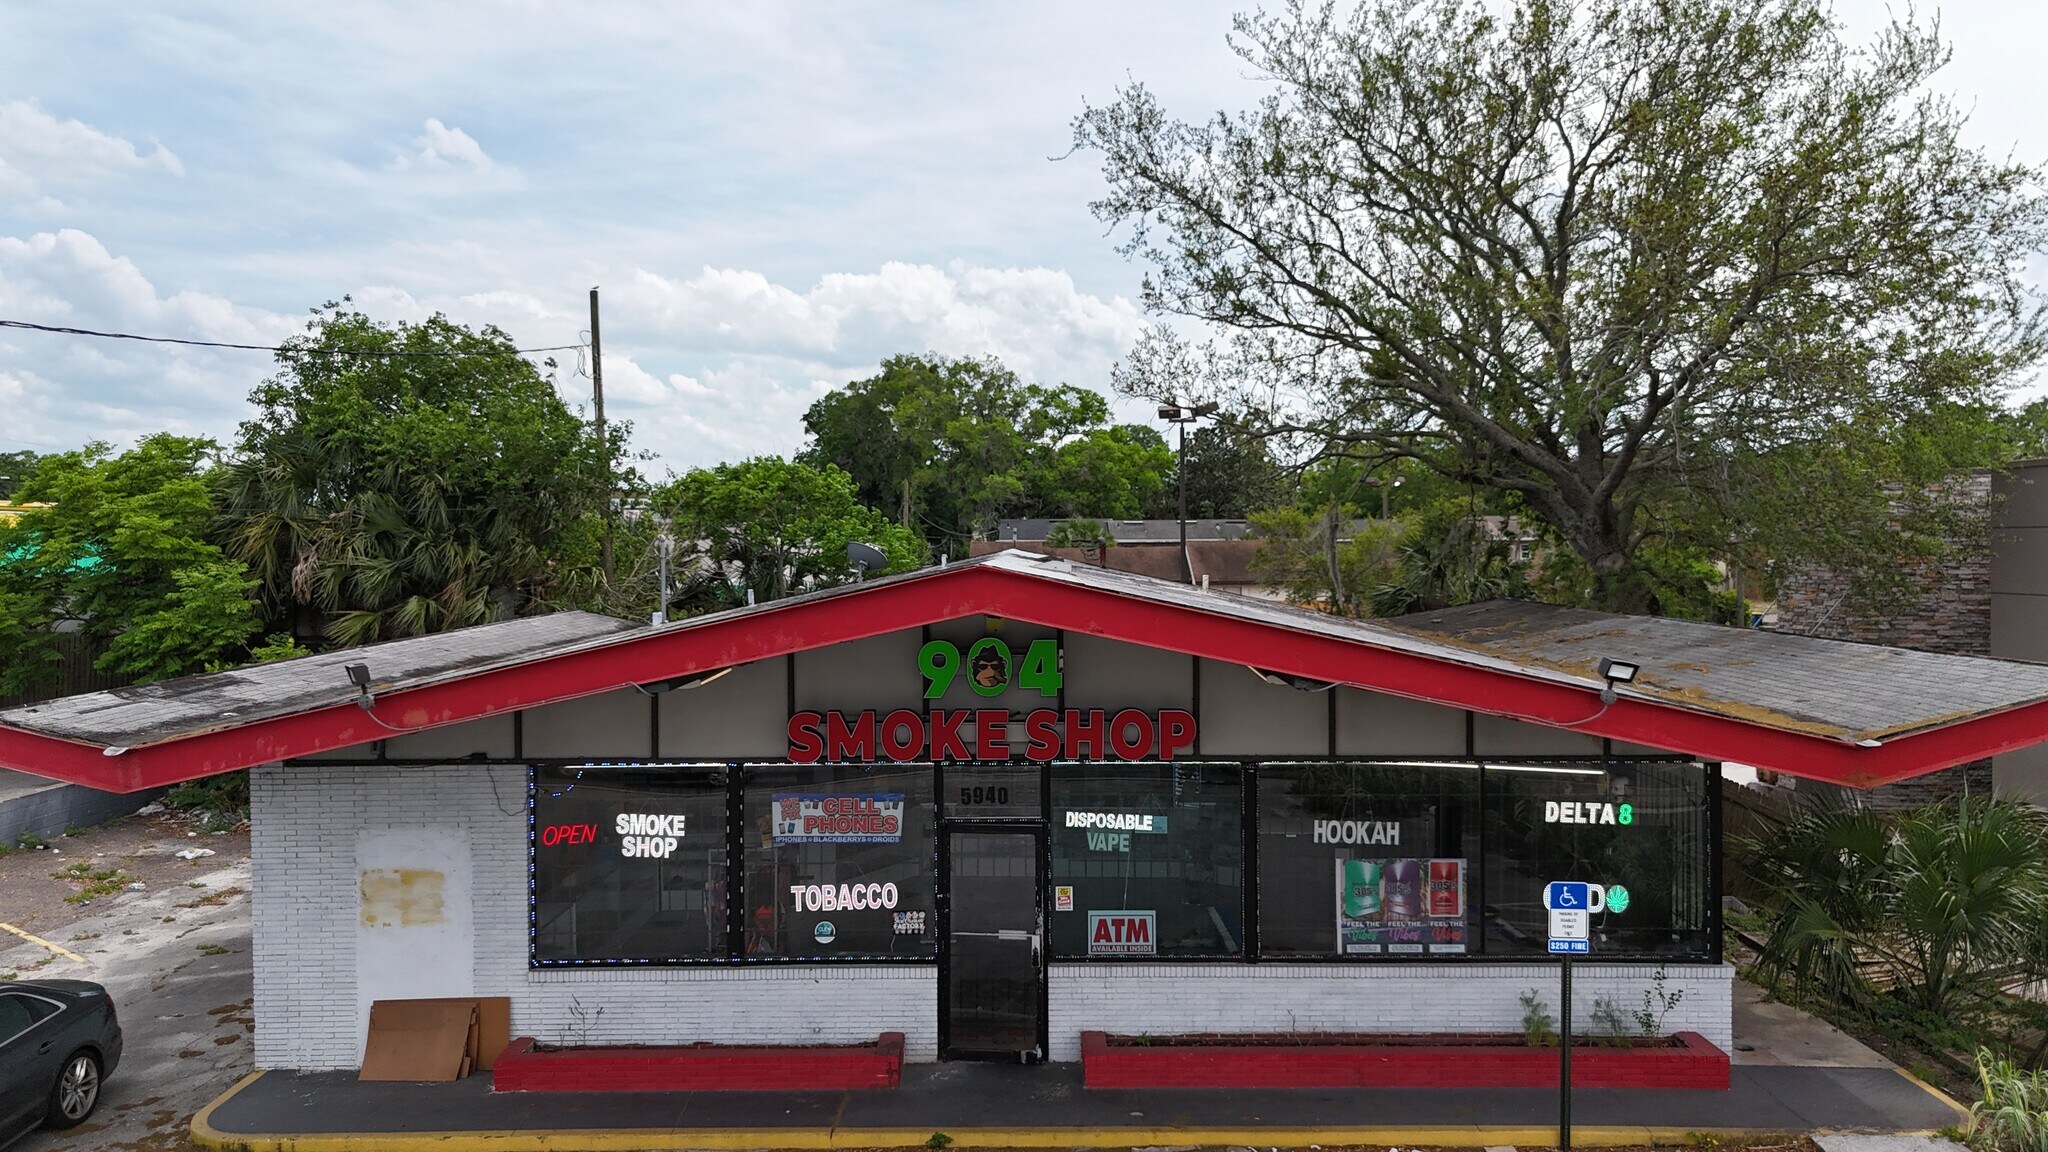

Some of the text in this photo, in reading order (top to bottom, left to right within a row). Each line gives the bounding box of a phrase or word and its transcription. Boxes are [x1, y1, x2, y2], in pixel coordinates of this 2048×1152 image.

[918, 638, 1063, 698] 904
[787, 709, 1197, 761] SMOKE SHOP
[822, 797, 880, 815] CELL
[960, 786, 1008, 805] 5940
[1066, 811, 1153, 831] DISPOSABLE
[1544, 801, 1633, 825] DELTA 8
[542, 824, 598, 846] OPEN
[615, 813, 685, 836] SMOKE
[804, 815, 899, 834] PHONES
[1313, 819, 1400, 845] HOOKAH
[621, 836, 678, 858] SHOP
[1087, 832, 1130, 852] VAPE
[790, 882, 899, 912] TOBACCO
[1093, 918, 1150, 943] ATM
[1550, 941, 1587, 950] $250 FINE
